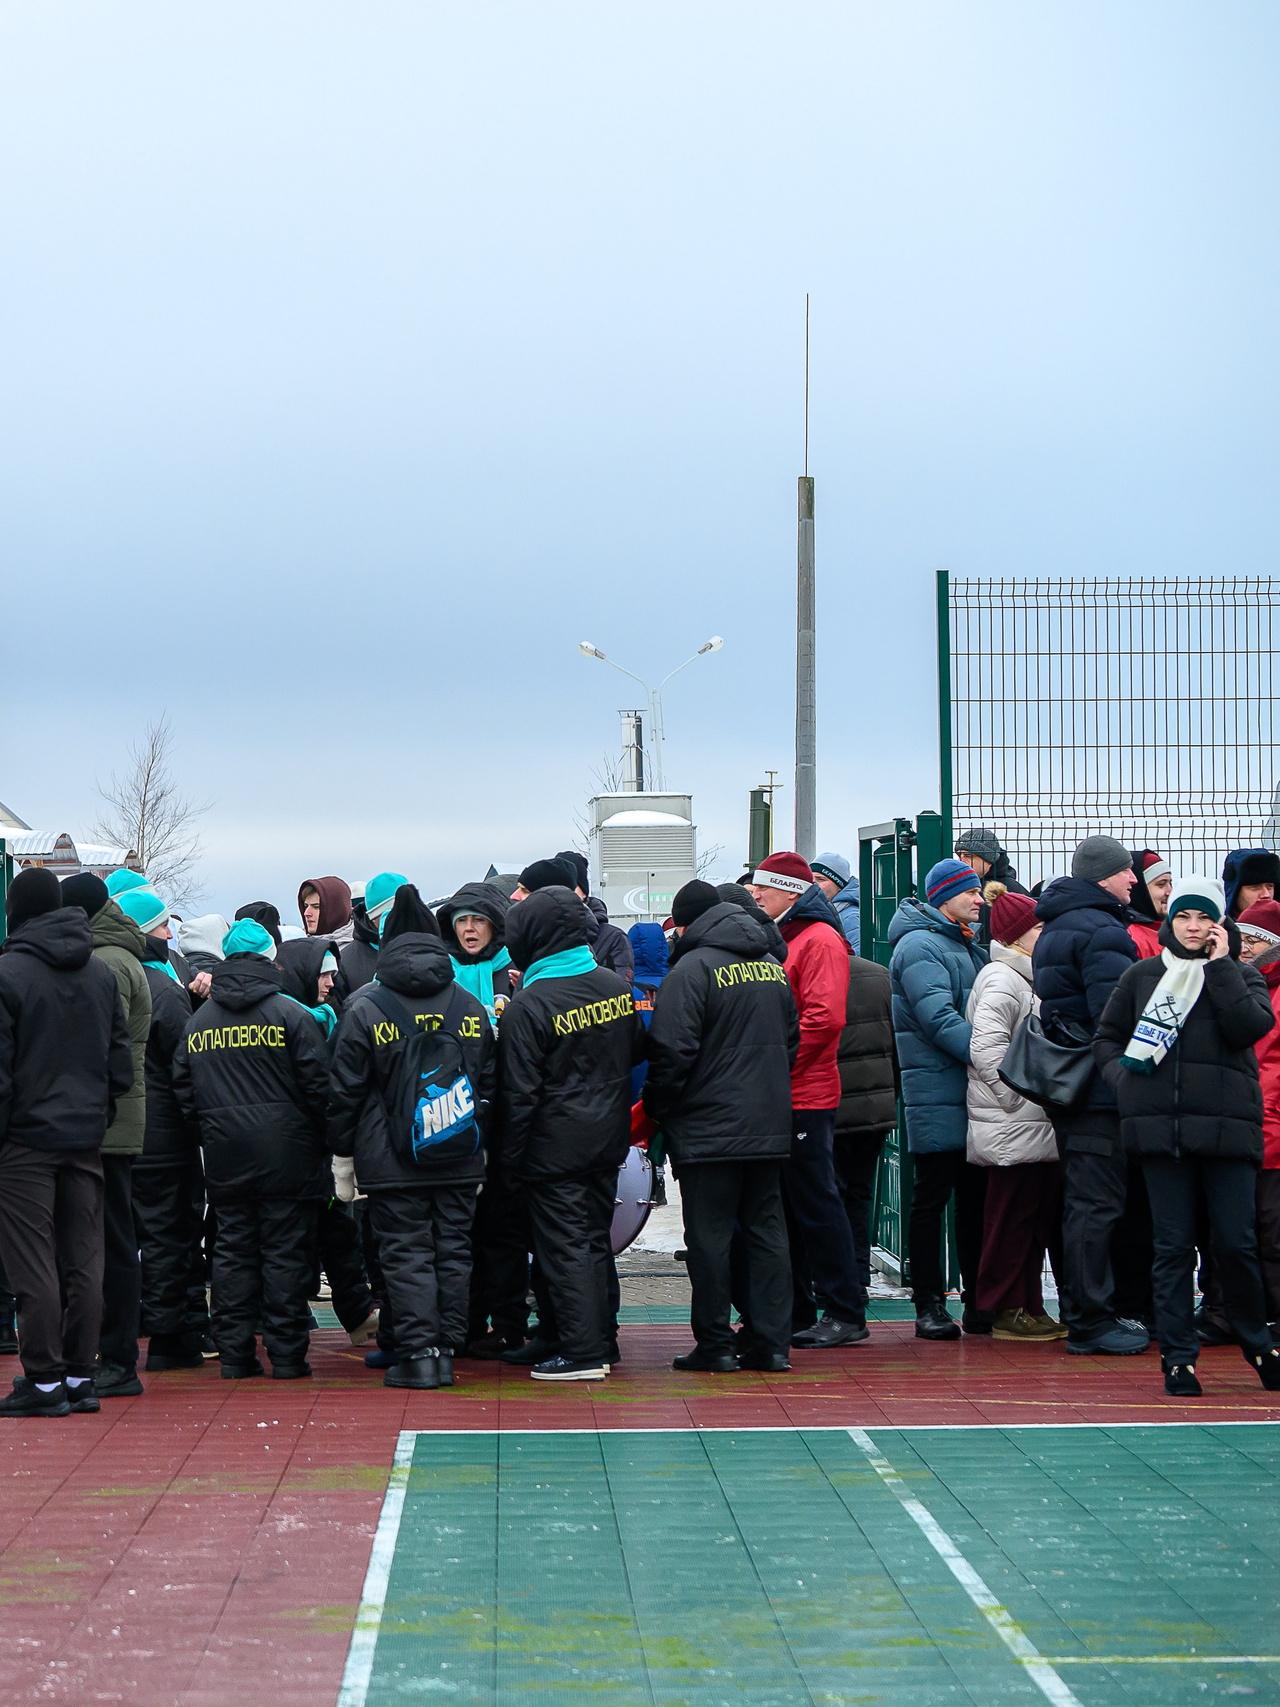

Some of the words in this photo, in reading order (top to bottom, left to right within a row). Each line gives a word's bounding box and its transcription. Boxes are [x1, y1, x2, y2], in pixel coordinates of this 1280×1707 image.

[769, 877, 803, 890] БЕЛАРУСЬ
[713, 961, 787, 988] КУПАЛОВСКОЕ
[552, 993, 634, 1036] КУПАЛОВСКОЕ
[187, 1024, 286, 1053] КУПАЛОВСКОЕ
[421, 1077, 475, 1139] NIKE
